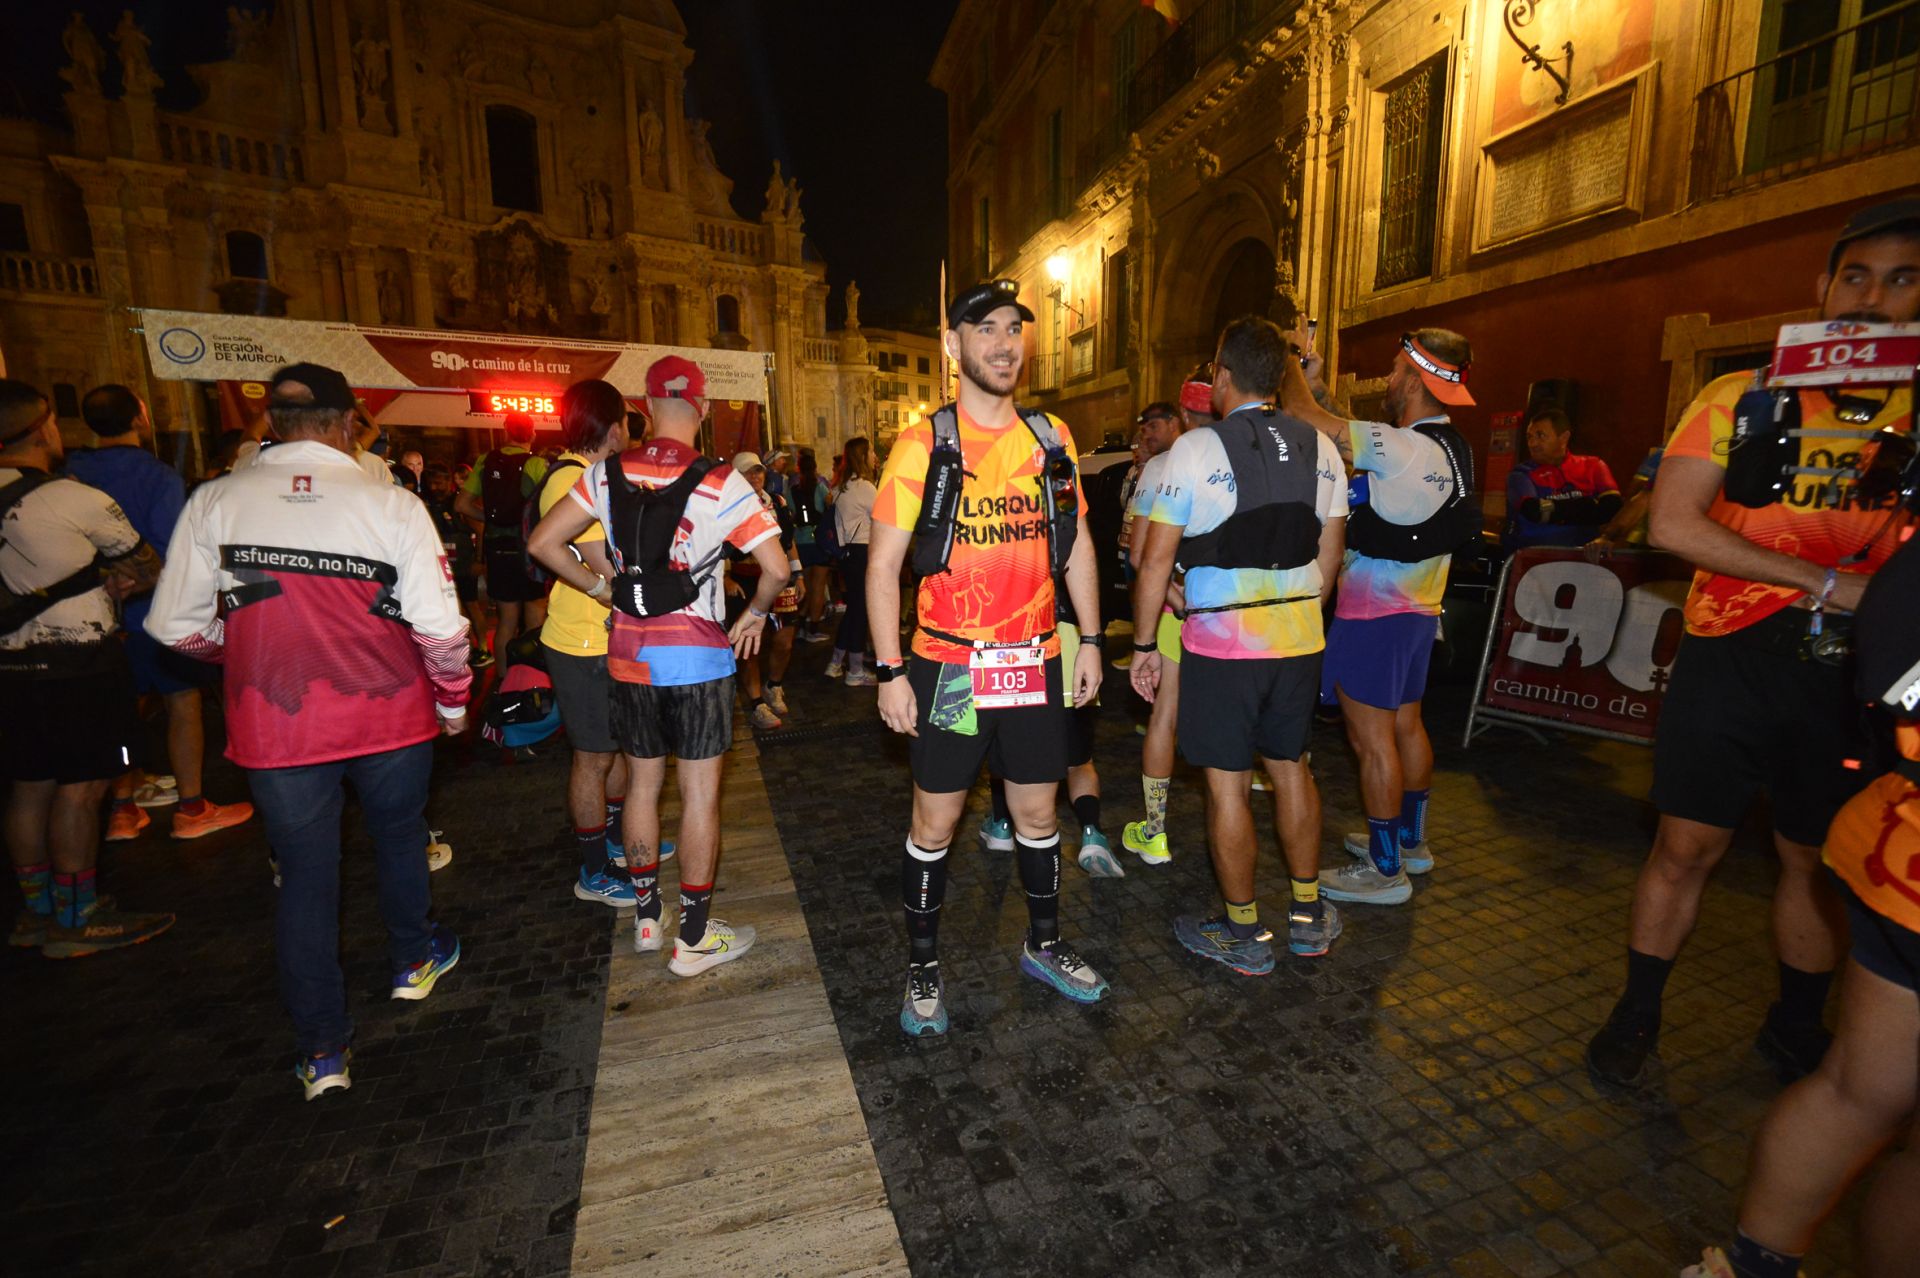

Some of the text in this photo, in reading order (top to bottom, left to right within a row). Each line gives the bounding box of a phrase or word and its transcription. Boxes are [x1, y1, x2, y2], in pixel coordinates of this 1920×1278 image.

[213, 342, 263, 353] REGIÓN
[215, 352, 287, 364] DE MURCIA
[1805, 342, 1878, 368] 104
[472, 356, 516, 372] camino
[517, 358, 532, 372] de
[534, 359, 545, 373] la
[546, 362, 571, 374] cruz
[490, 395, 555, 413] 5:43:36
[1267, 425, 1289, 463] EVADICT
[931, 464, 949, 519] MARLOAR
[318, 558, 342, 572] no
[346, 557, 377, 579] hay
[1508, 561, 1684, 692] 90
[991, 670, 1027, 690] 103
[1493, 678, 1648, 719] camino de
